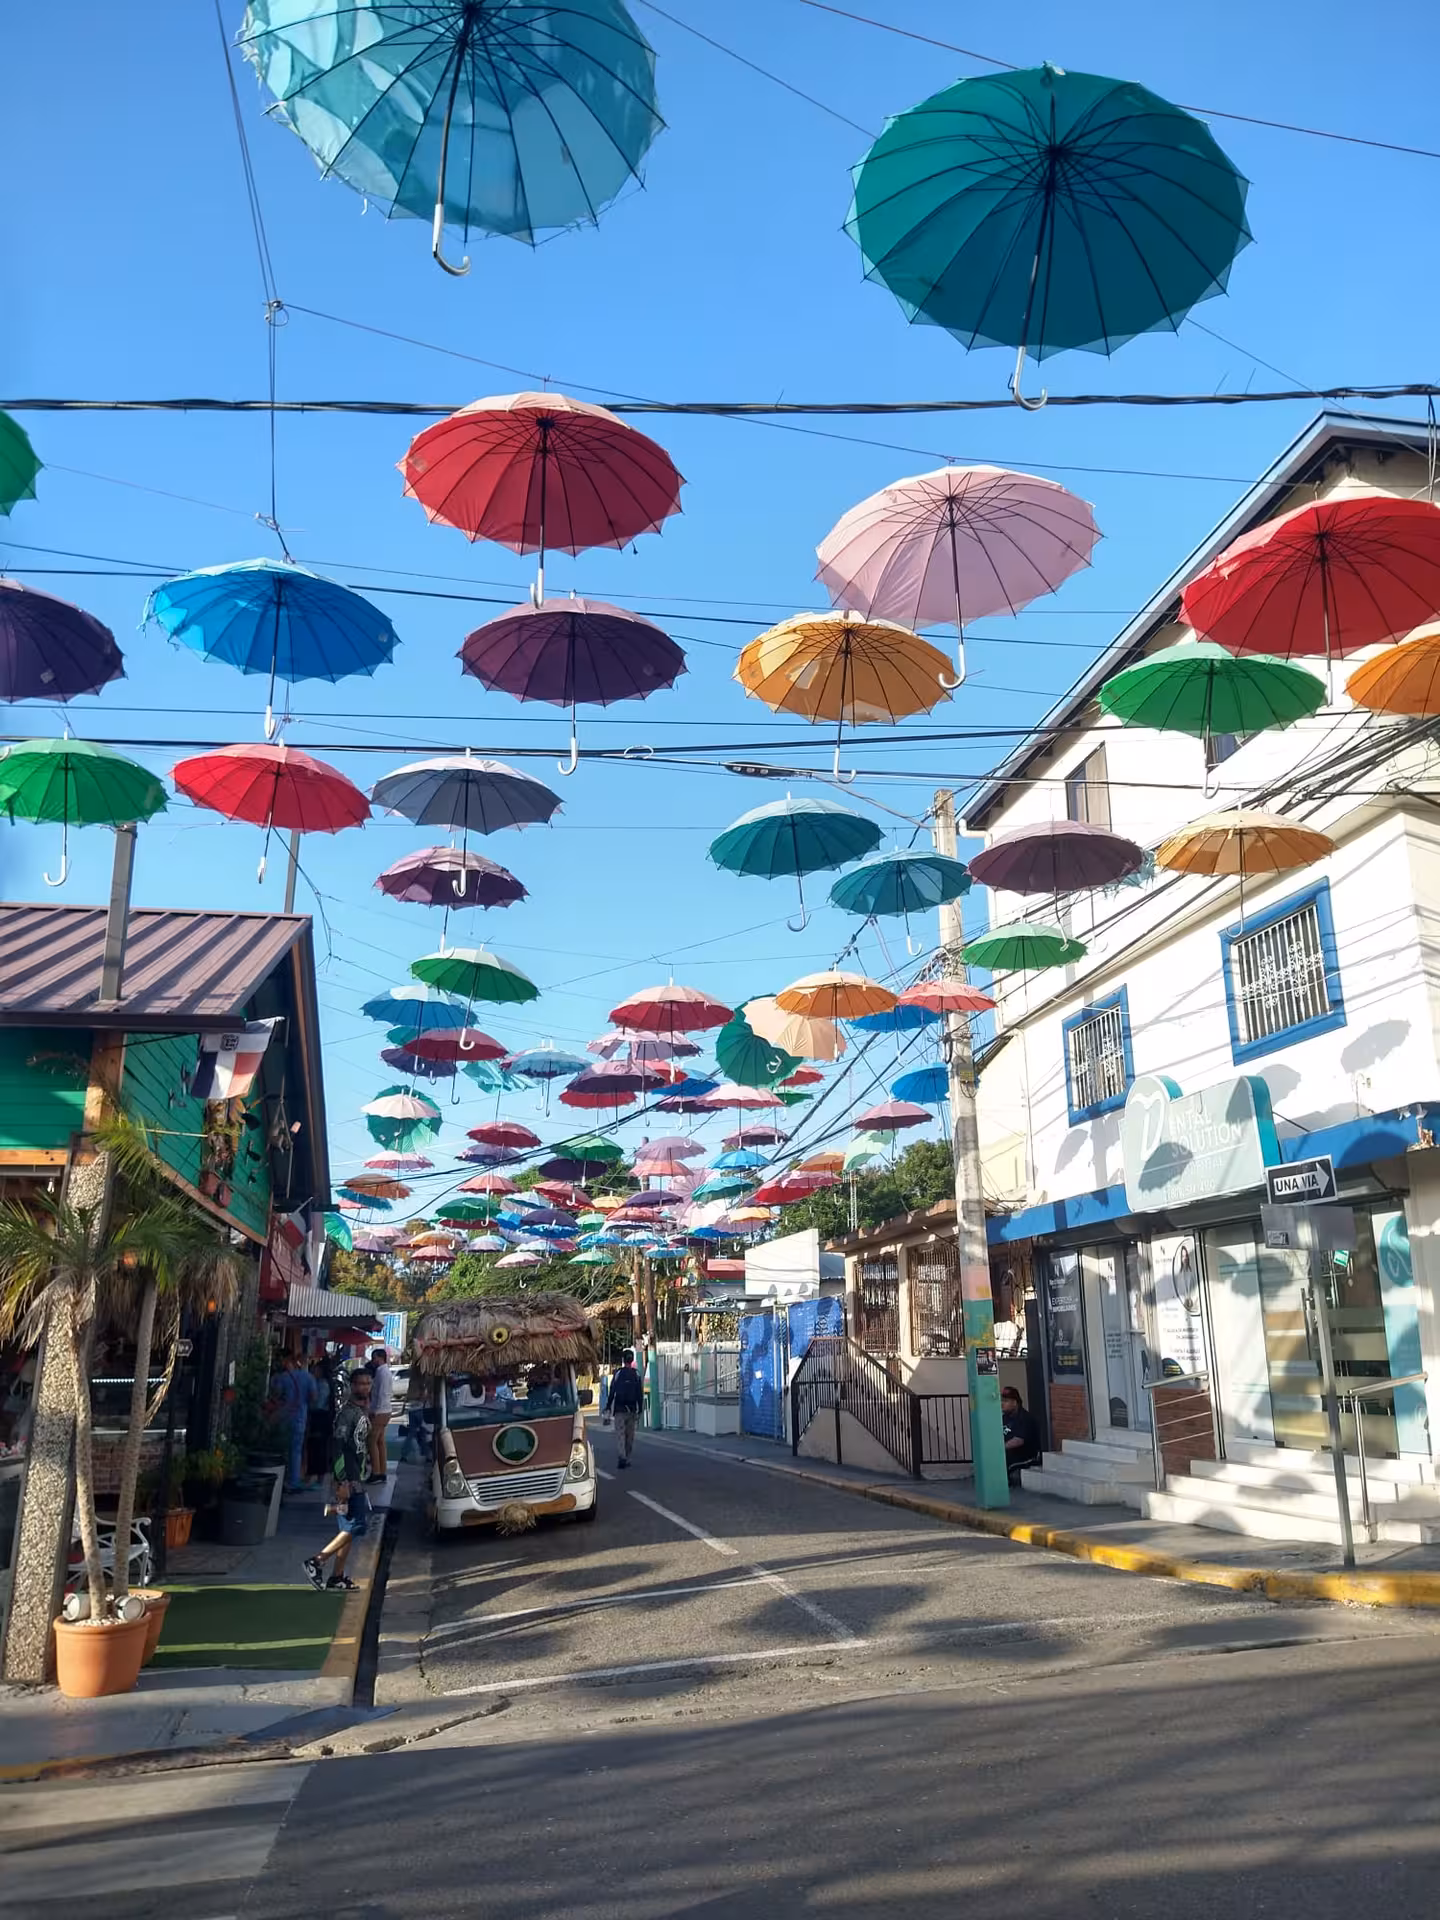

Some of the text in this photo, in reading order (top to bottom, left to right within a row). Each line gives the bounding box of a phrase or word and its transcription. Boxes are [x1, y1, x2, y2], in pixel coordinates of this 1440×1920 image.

[1171, 1119, 1242, 1158] SOLUTION
[1276, 1174, 1319, 1192] UNA VIA
